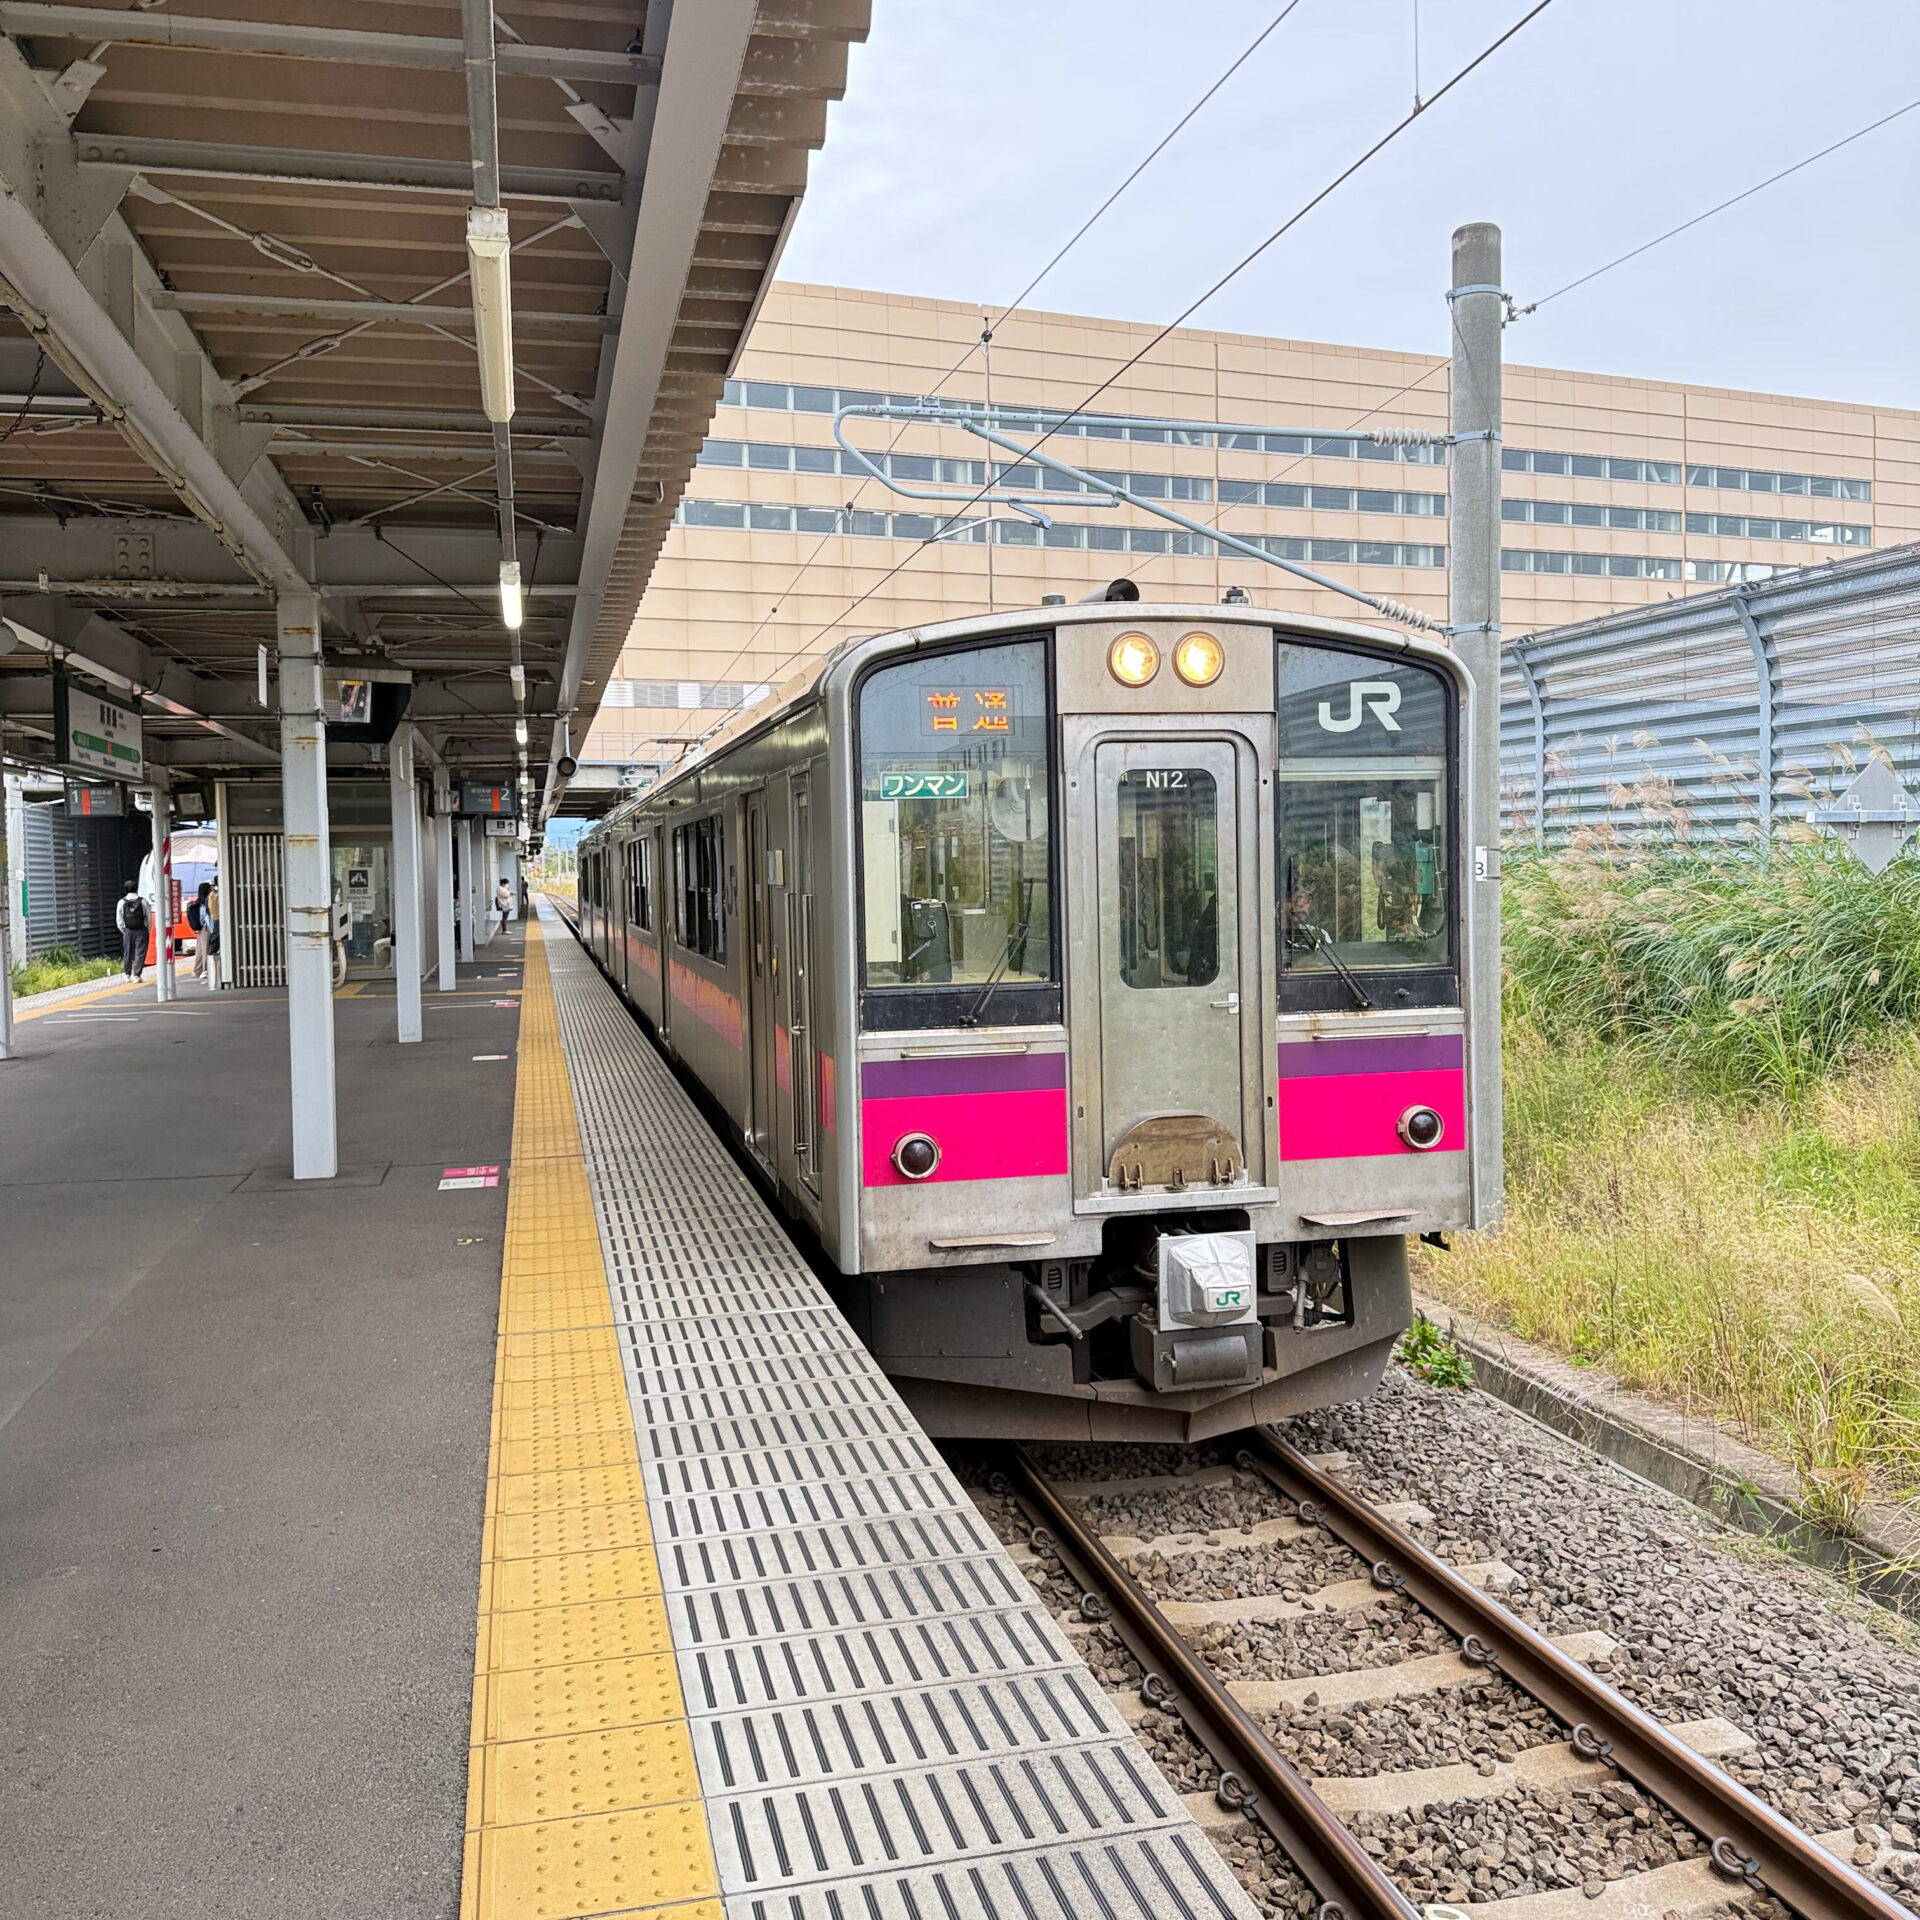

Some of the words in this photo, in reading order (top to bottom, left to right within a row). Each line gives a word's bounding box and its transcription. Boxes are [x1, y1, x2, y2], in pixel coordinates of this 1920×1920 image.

[926, 691, 1009, 730] 普通
[1318, 681, 1402, 732] JR
[500, 788, 510, 800] 2
[884, 775, 965, 796] ワンマン
[71, 789, 78, 803] 1
[1216, 1291, 1240, 1306] JR
